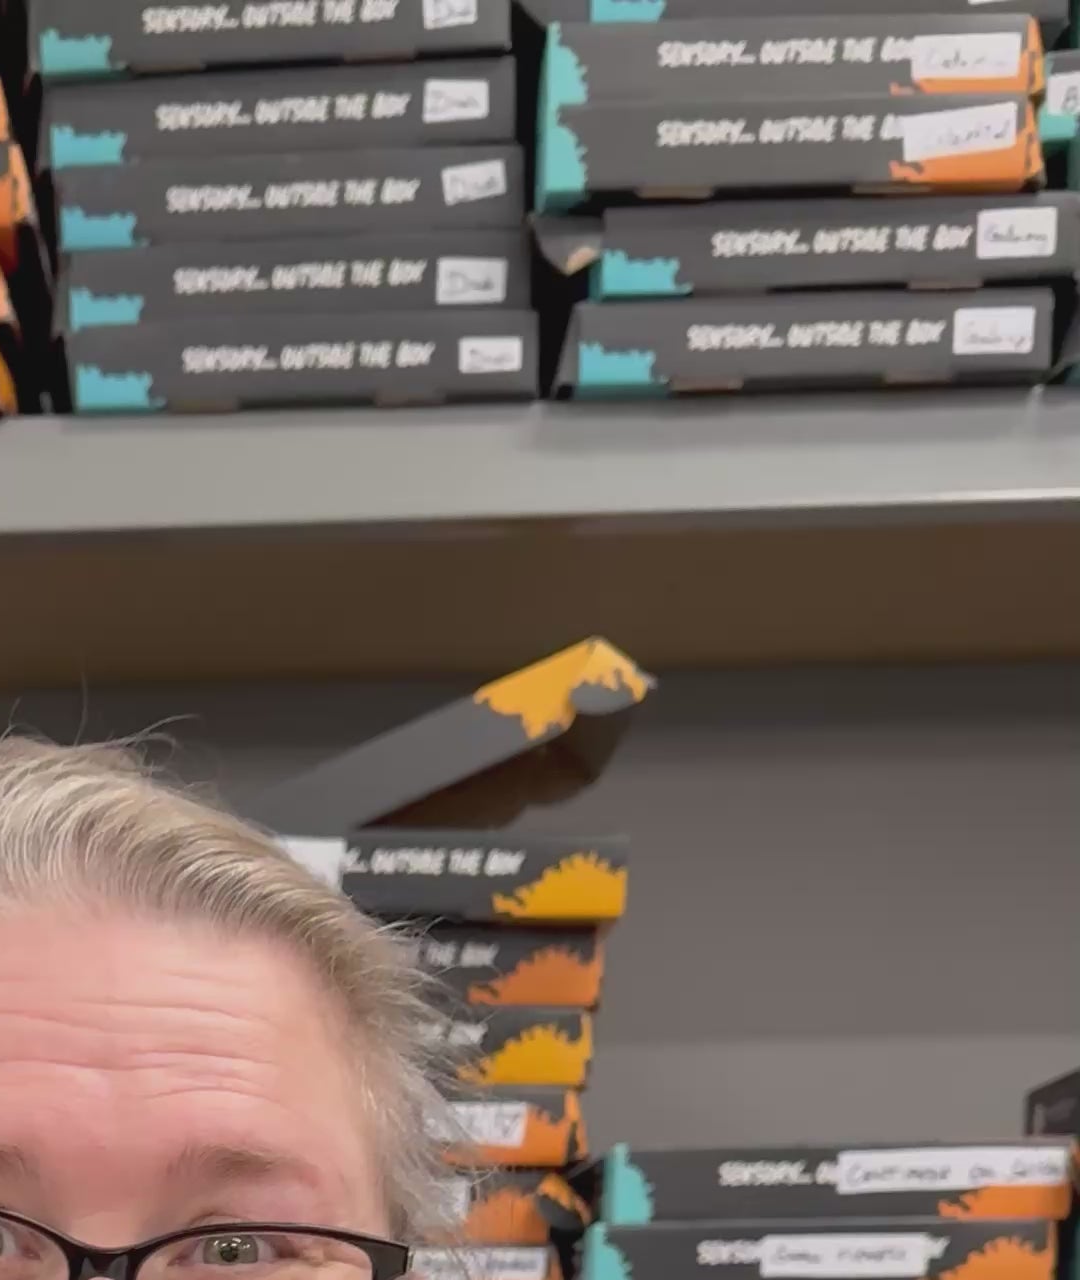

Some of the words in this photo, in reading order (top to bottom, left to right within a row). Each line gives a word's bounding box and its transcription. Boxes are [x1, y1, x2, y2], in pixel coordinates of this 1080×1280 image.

[759, 37, 838, 65] OUTSIDE
[842, 36, 876, 63] THE
[255, 96, 331, 124] OUTSIDE
[335, 94, 368, 121] THE
[372, 93, 411, 119] BOX
[759, 116, 838, 144] OUTSIDE
[842, 114, 876, 141] THE
[265, 180, 340, 208] OUTSIDE
[344, 179, 377, 206] THE
[381, 178, 421, 205] BOX
[813, 226, 892, 254] OUTSIDE
[895, 226, 930, 252] THE
[933, 224, 974, 251] BOX
[272, 261, 347, 290] OUTSIDE
[351, 260, 384, 287] THE
[387, 260, 427, 286] BOX
[787, 321, 865, 348] OUTSIDE
[868, 320, 902, 346] THE
[906, 319, 946, 345] BOX
[280, 344, 356, 370] OUTSIDE
[360, 342, 393, 369] THE
[396, 341, 435, 368] BOX
[371, 848, 446, 876] OUTSIDE
[448, 849, 483, 877] THE
[484, 849, 527, 877] BOX
